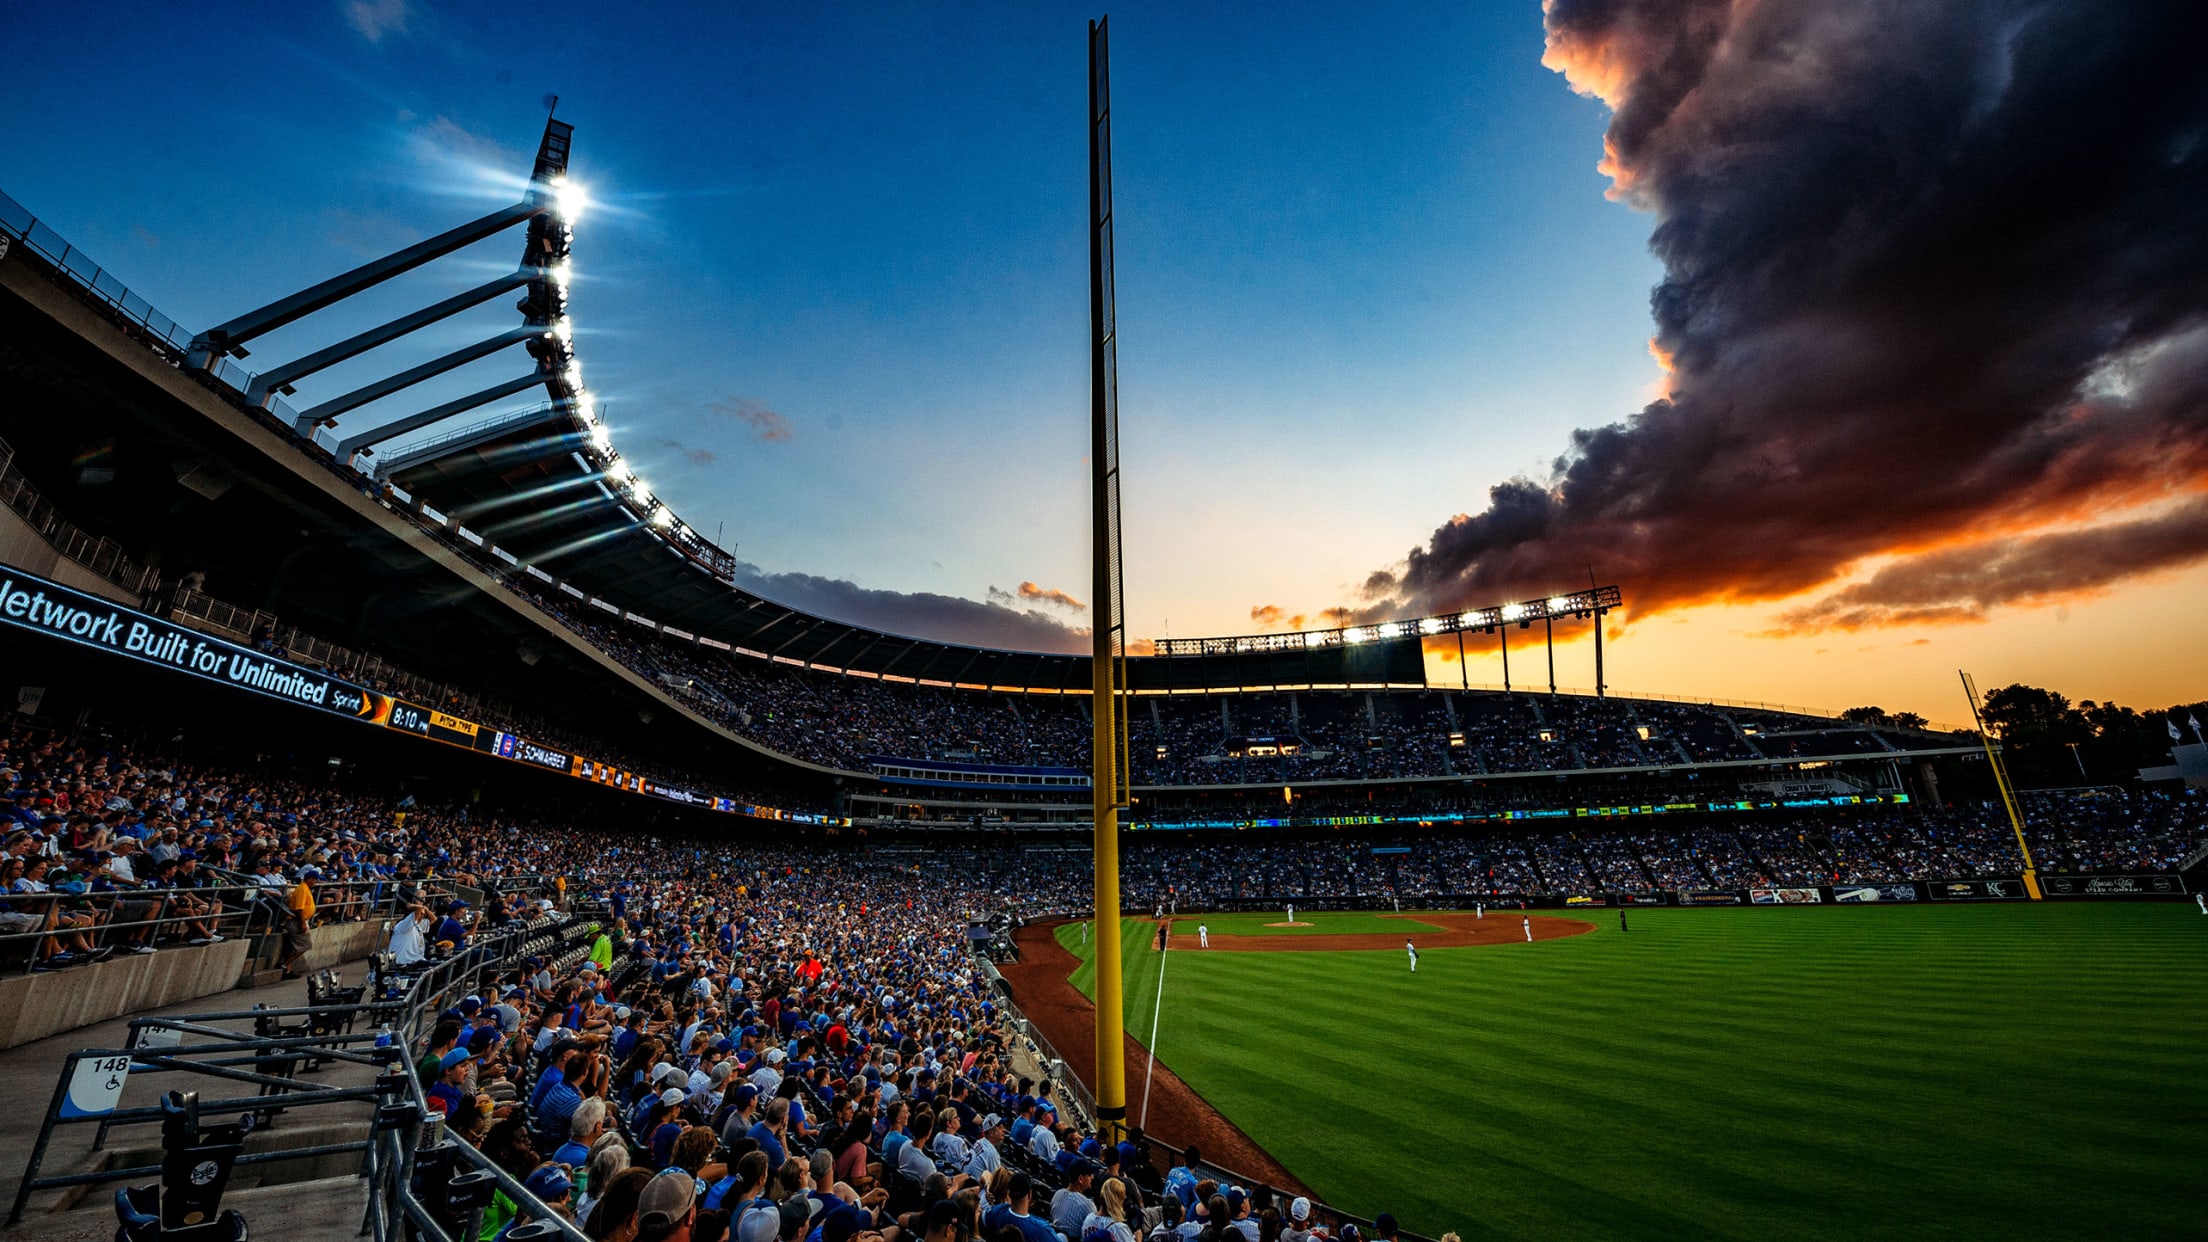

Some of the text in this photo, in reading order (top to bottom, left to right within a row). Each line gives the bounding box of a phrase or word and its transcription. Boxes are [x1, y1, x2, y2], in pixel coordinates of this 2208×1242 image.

[125, 621, 190, 665] Built
[190, 642, 227, 674] for
[228, 654, 329, 705] Unlimited
[331, 690, 361, 712] Sprint
[393, 707, 418, 729] 8:10
[439, 715, 473, 733] PITCH TYPE
[524, 744, 567, 770] SCHWARBER
[93, 1057, 129, 1073] 148
